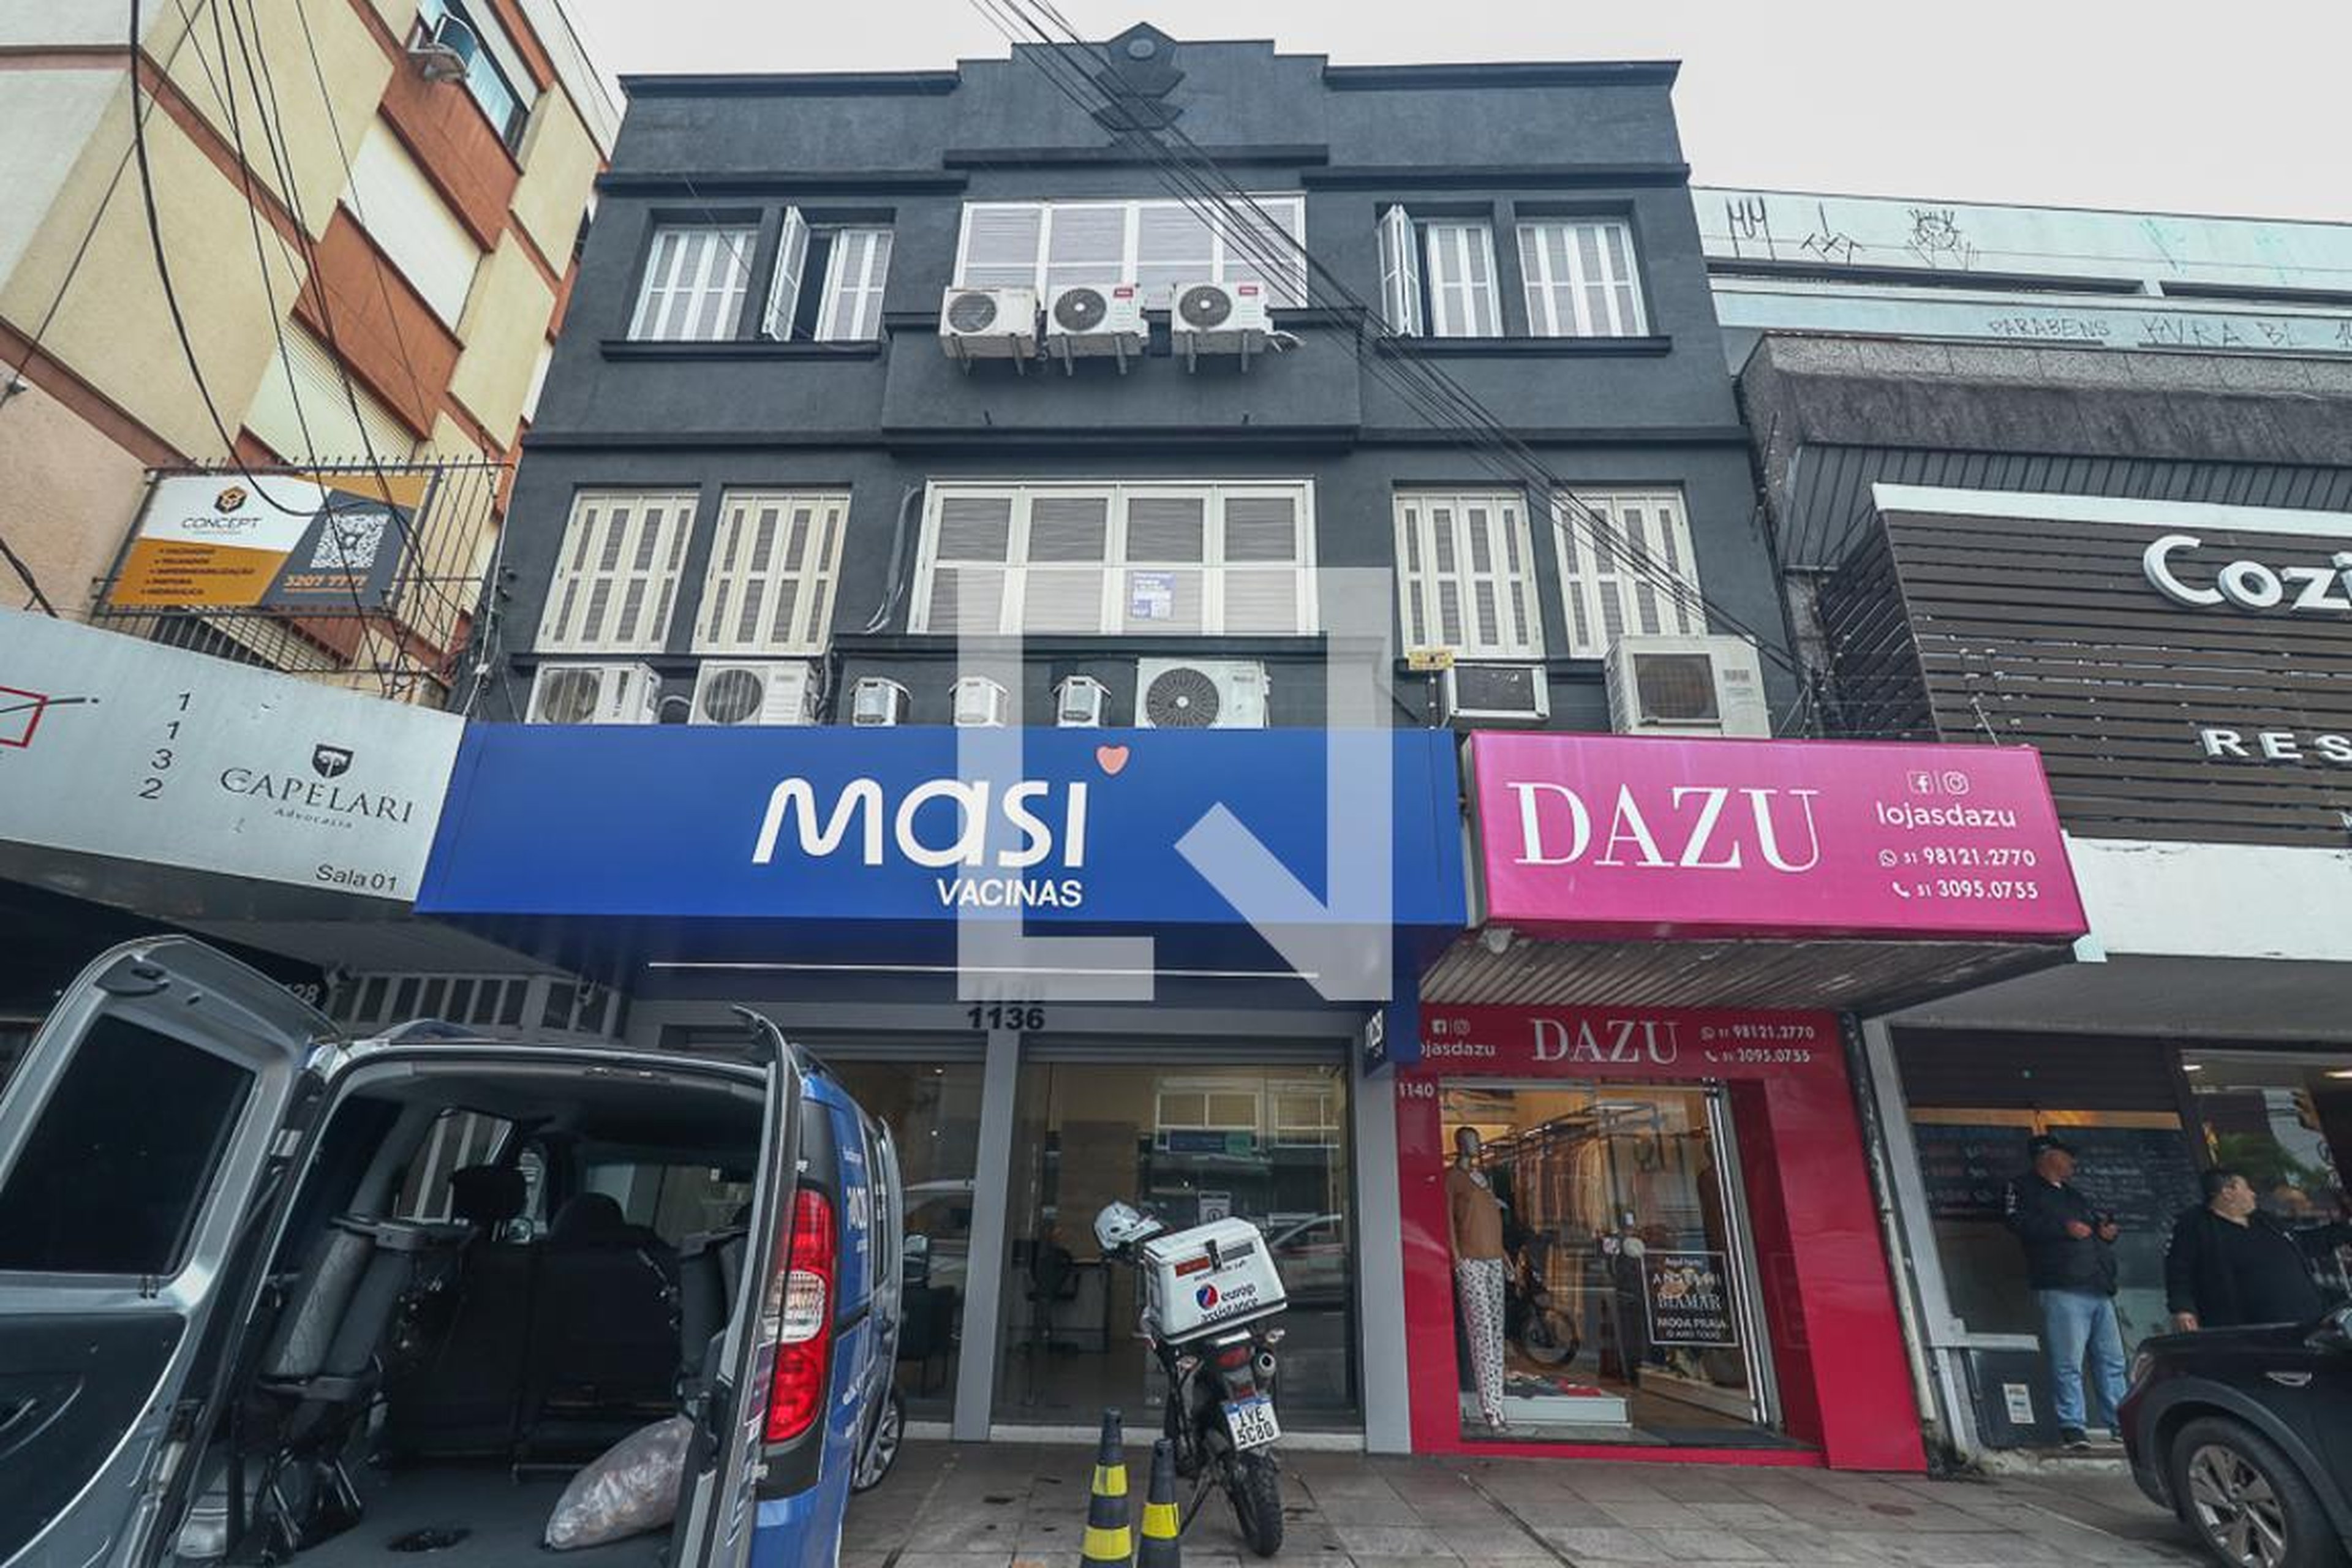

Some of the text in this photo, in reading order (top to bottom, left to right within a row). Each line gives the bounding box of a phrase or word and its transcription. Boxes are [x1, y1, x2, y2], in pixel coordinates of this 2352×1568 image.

[182, 517, 262, 529] CONCEPT
[2202, 729, 2352, 761] RES
[220, 767, 413, 823] CAPELARI
[1506, 782, 1820, 873] DAZU
[1876, 801, 2017, 831] lojasdazu
[1923, 846, 2036, 867] 98121.2770
[315, 864, 397, 891] Sala 01
[1937, 880, 2038, 899] 3095.0755
[936, 878, 1084, 907] VACINAS
[285, 982, 320, 1005] 28
[968, 1007, 1045, 1030] 1136
[1531, 1017, 1681, 1064] DAZU
[1398, 1081, 1434, 1098] 1140
